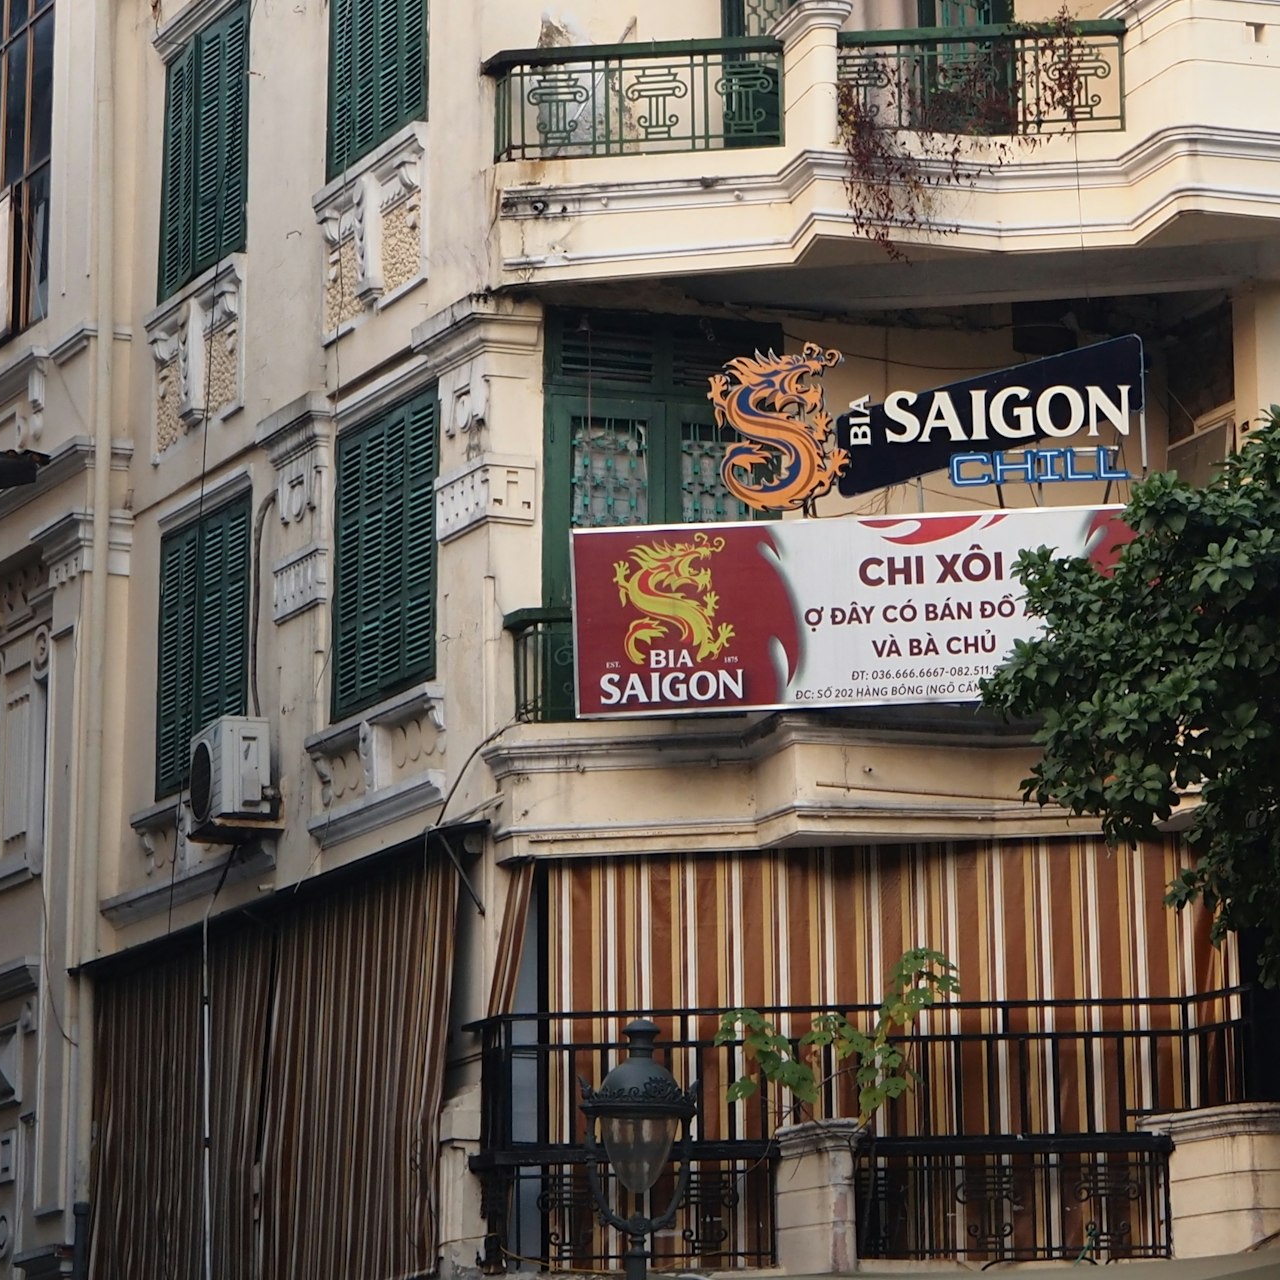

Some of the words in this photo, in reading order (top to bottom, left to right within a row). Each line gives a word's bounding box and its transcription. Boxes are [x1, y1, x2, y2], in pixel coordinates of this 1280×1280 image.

[849, 394, 872, 447] BIA
[884, 385, 1131, 444] SAIGON
[949, 445, 1129, 487] CHILL
[858, 554, 925, 587] CHI
[935, 543, 1004, 584] XÔI
[830, 601, 876, 626] ĐÂY
[882, 598, 918, 623] CÓ
[924, 596, 973, 622] BÁN
[979, 593, 1016, 618] ĐỒ
[649, 649, 694, 669] BIA
[871, 633, 902, 658] VÀ
[908, 632, 940, 657] BÀ
[946, 629, 997, 655] CHỦ
[606, 661, 621, 669] EST.
[724, 656, 739, 664] 1875
[851, 670, 869, 681] ĐT:
[600, 669, 744, 705] SAIGON
[795, 690, 815, 700] ĐC:
[817, 685, 833, 699] SỐ
[834, 688, 854, 699] 202
[856, 684, 888, 698] HÀNG
[891, 683, 924, 696] BÔNG
